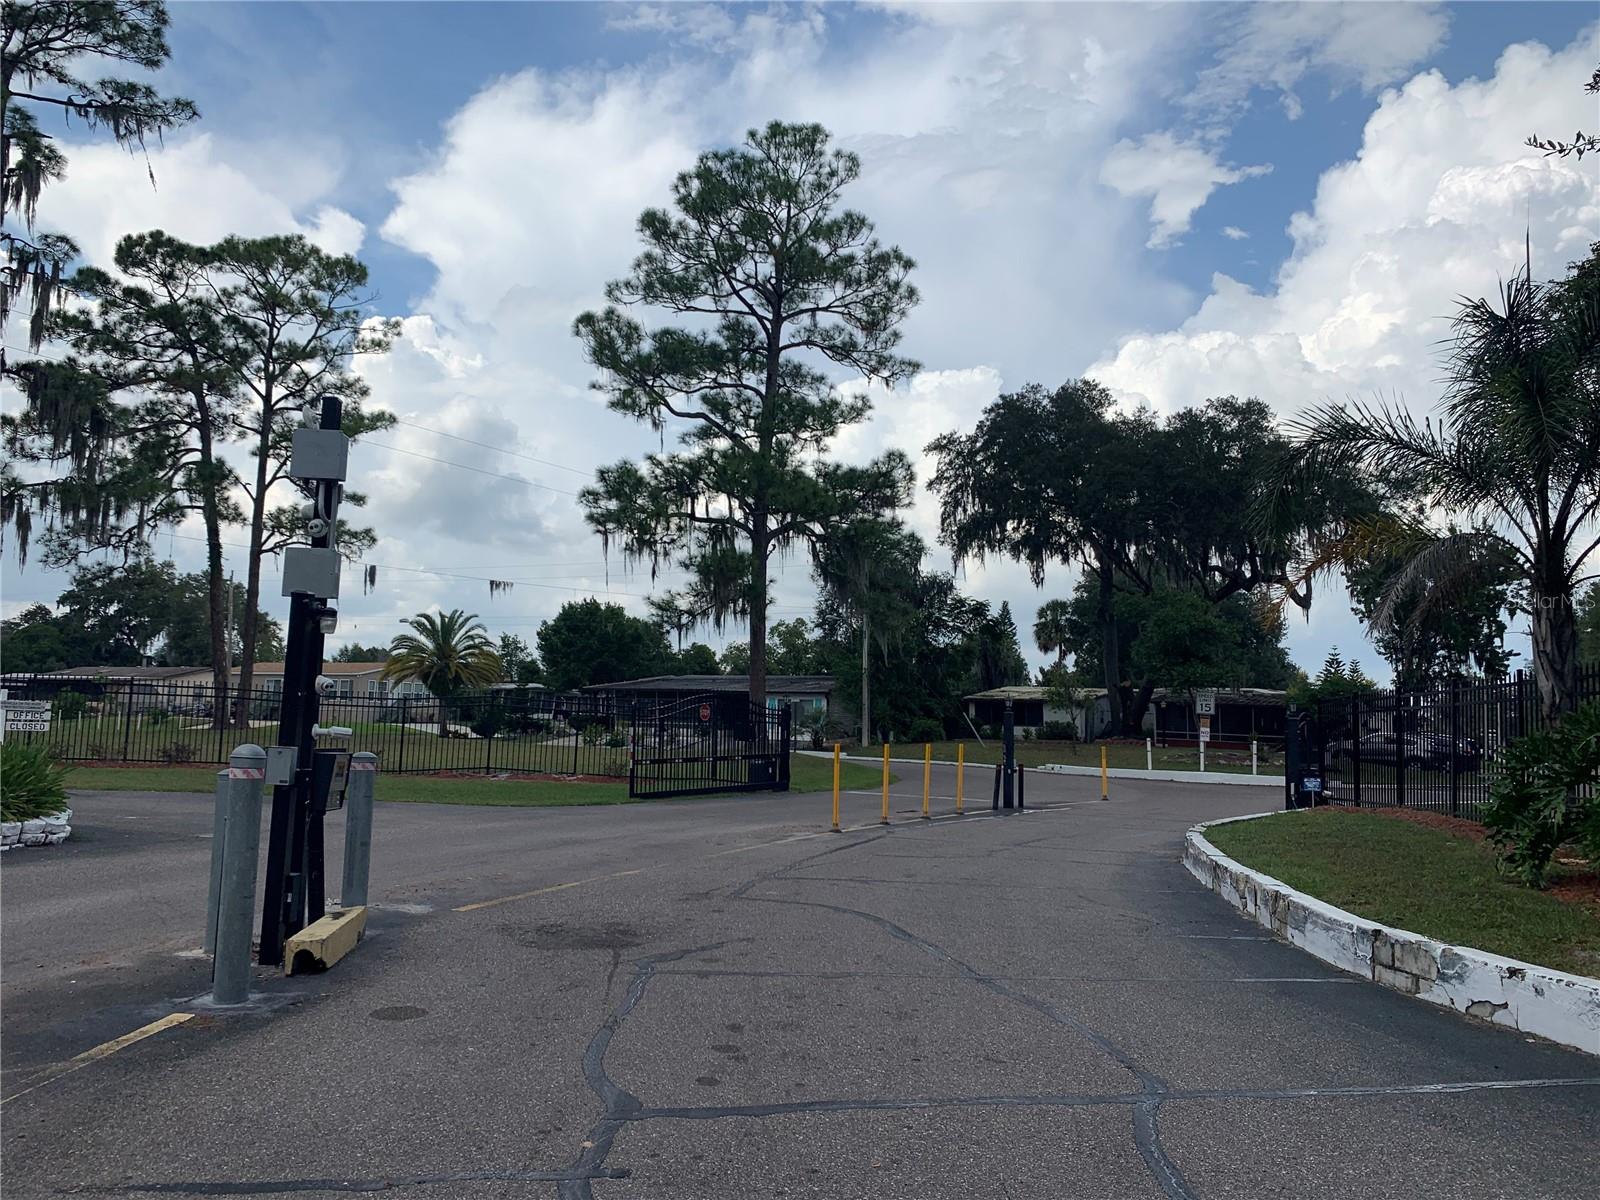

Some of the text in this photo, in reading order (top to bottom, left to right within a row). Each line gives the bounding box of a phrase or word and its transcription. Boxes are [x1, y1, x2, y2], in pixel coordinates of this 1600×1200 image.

[1200, 703, 1212, 712] 15
[13, 711, 45, 719] OFFICE
[9, 722, 46, 730] CLOSED
